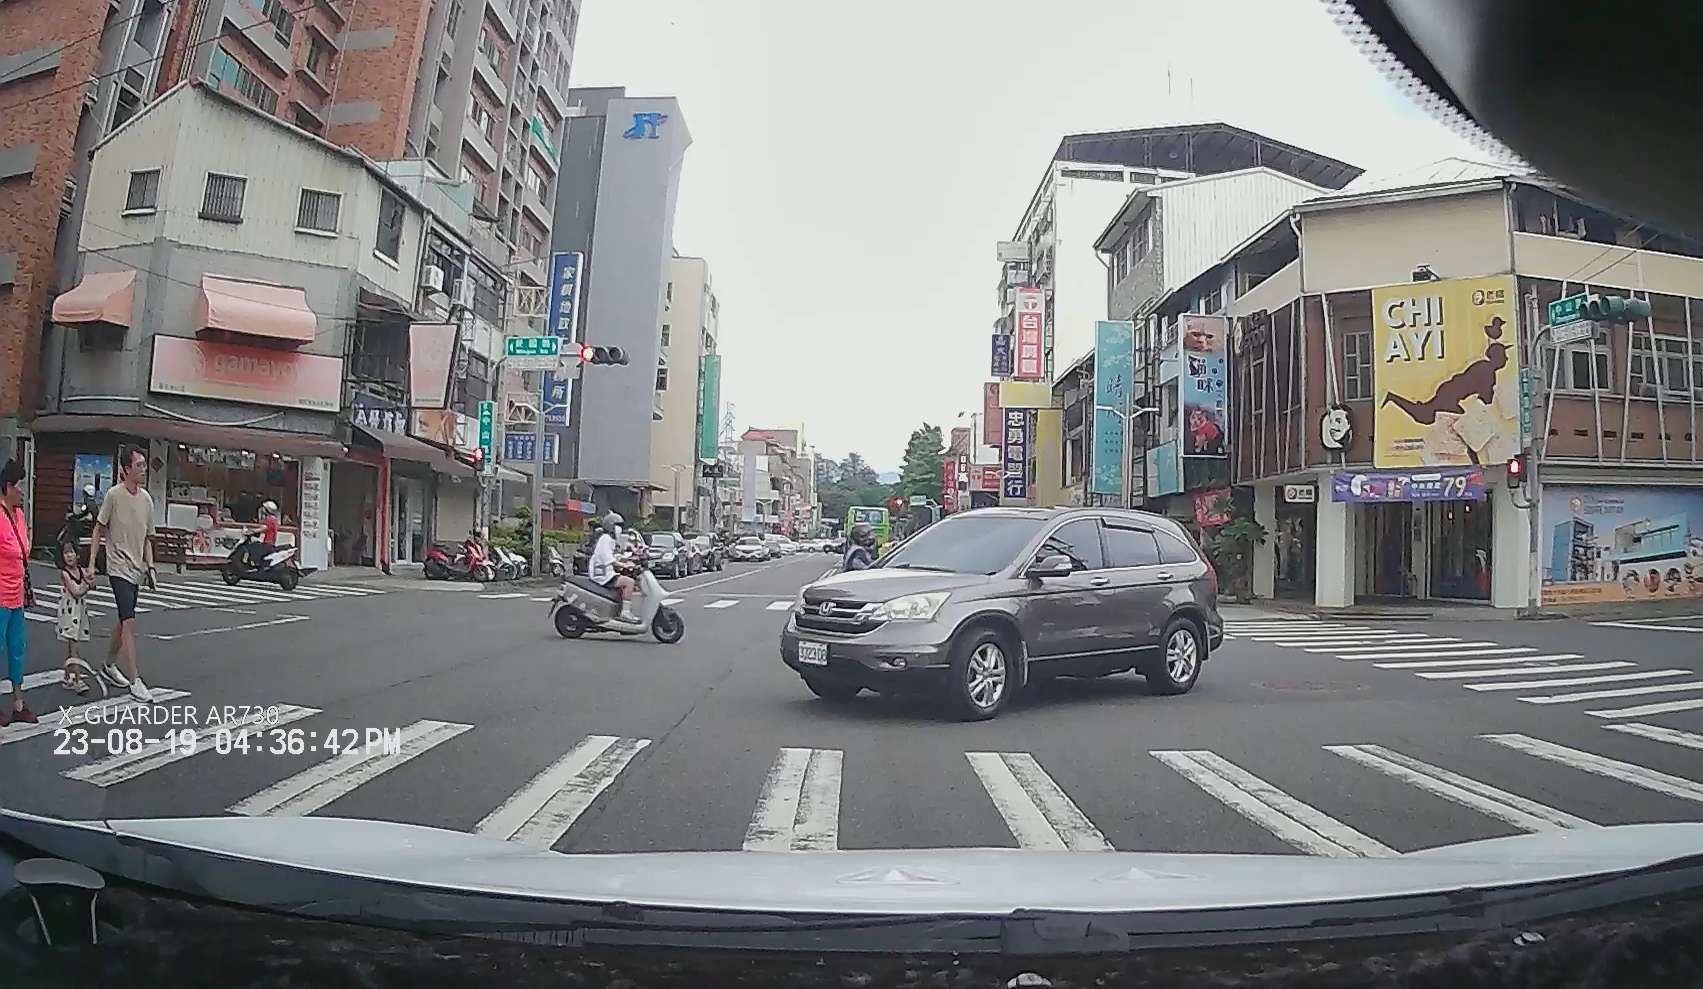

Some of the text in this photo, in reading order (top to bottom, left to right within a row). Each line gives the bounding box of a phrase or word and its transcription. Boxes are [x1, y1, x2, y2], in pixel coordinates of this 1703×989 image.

[1382, 297, 1443, 328] CHI
[1386, 330, 1444, 362] AYI
[1443, 476, 1466, 497] 79
